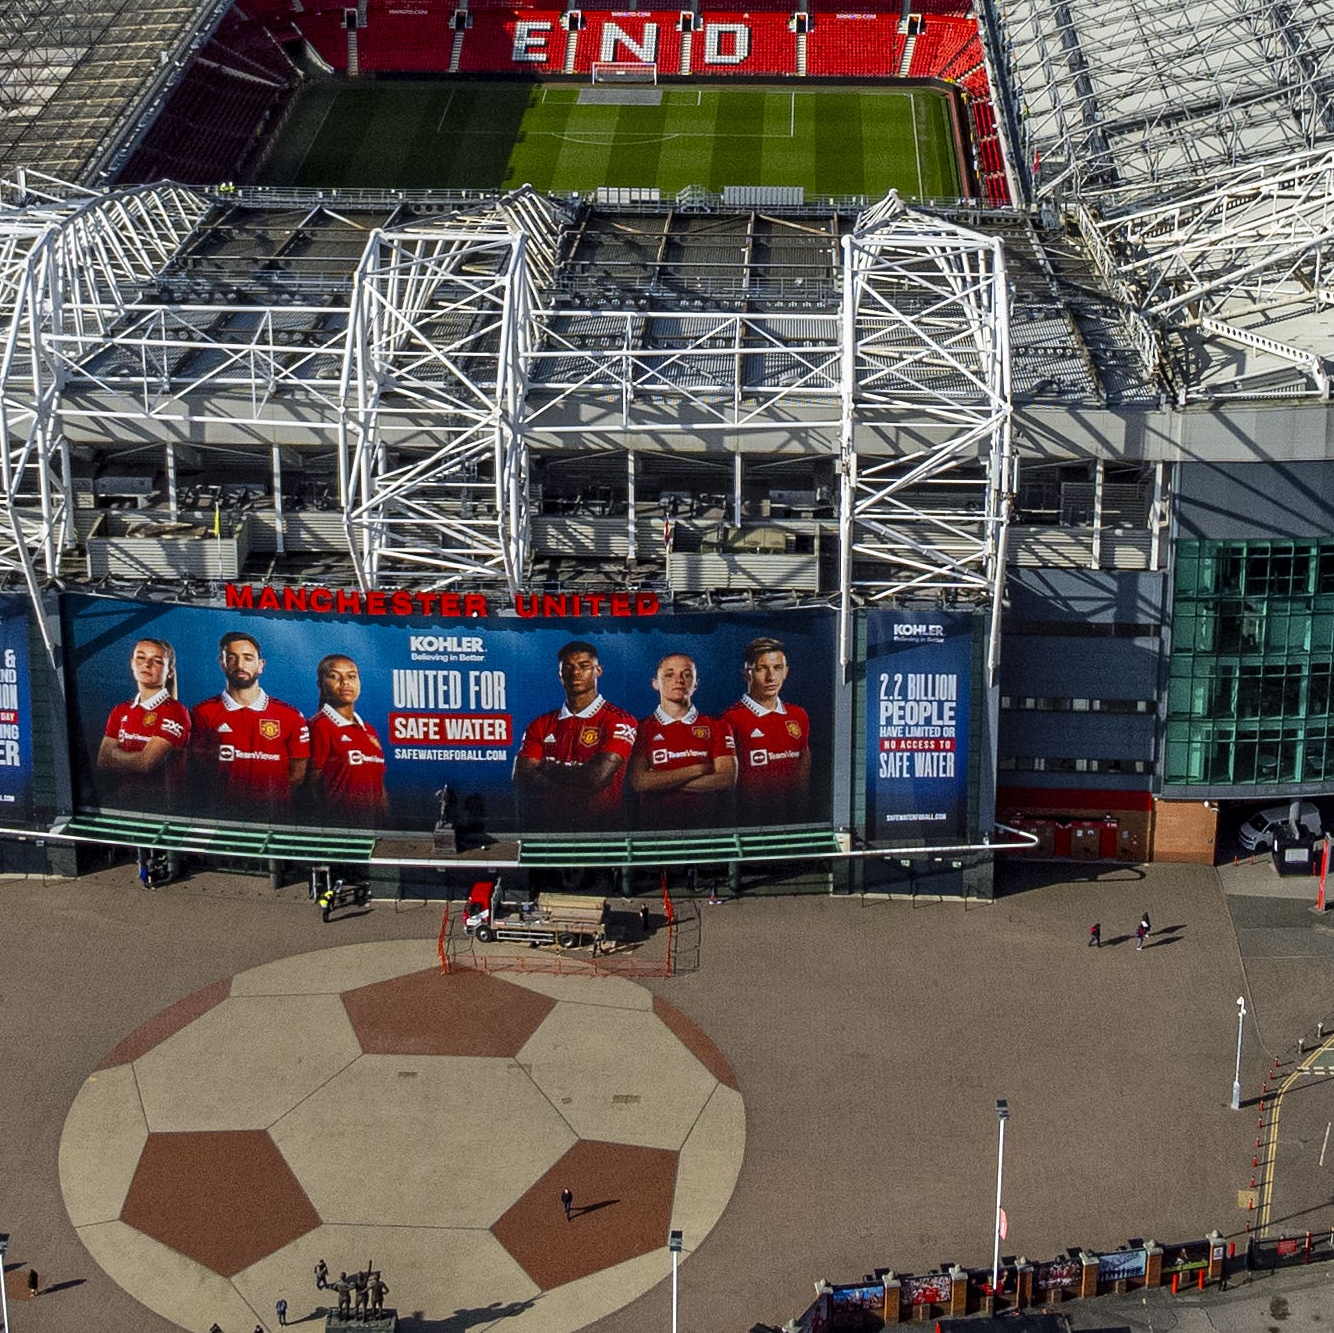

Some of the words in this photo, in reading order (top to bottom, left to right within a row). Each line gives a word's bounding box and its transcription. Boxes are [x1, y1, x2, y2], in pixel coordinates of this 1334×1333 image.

[513, 19, 752, 65] END
[224, 582, 489, 617] MANCHESTER
[514, 591, 660, 618] UNITED
[893, 624, 944, 636] KOHLER
[410, 636, 484, 652] KOHLER
[4, 648, 16, 668] &
[411, 653, 449, 662] Believing
[450, 653, 458, 661] in
[459, 653, 485, 662] Better
[392, 669, 462, 709] UNITED
[469, 670, 507, 710] FOR
[879, 672, 903, 701] 2.2
[907, 673, 957, 701] BILLION
[1, 712, 15, 722] DAY
[879, 700, 957, 726] PEOPLE
[394, 717, 440, 739] SAFE
[445, 718, 508, 741] WATER
[879, 726, 904, 738] HAVE
[905, 726, 941, 738] LIMITED
[942, 726, 956, 738] OR
[884, 740, 896, 749] NO
[900, 740, 935, 749] ACCESS
[939, 740, 951, 749] TO
[234, 749, 281, 761] TeamViewer
[394, 748, 508, 761] SAFEWATERFORALL.COM
[879, 752, 910, 778] SAFE
[914, 752, 955, 778] WATER
